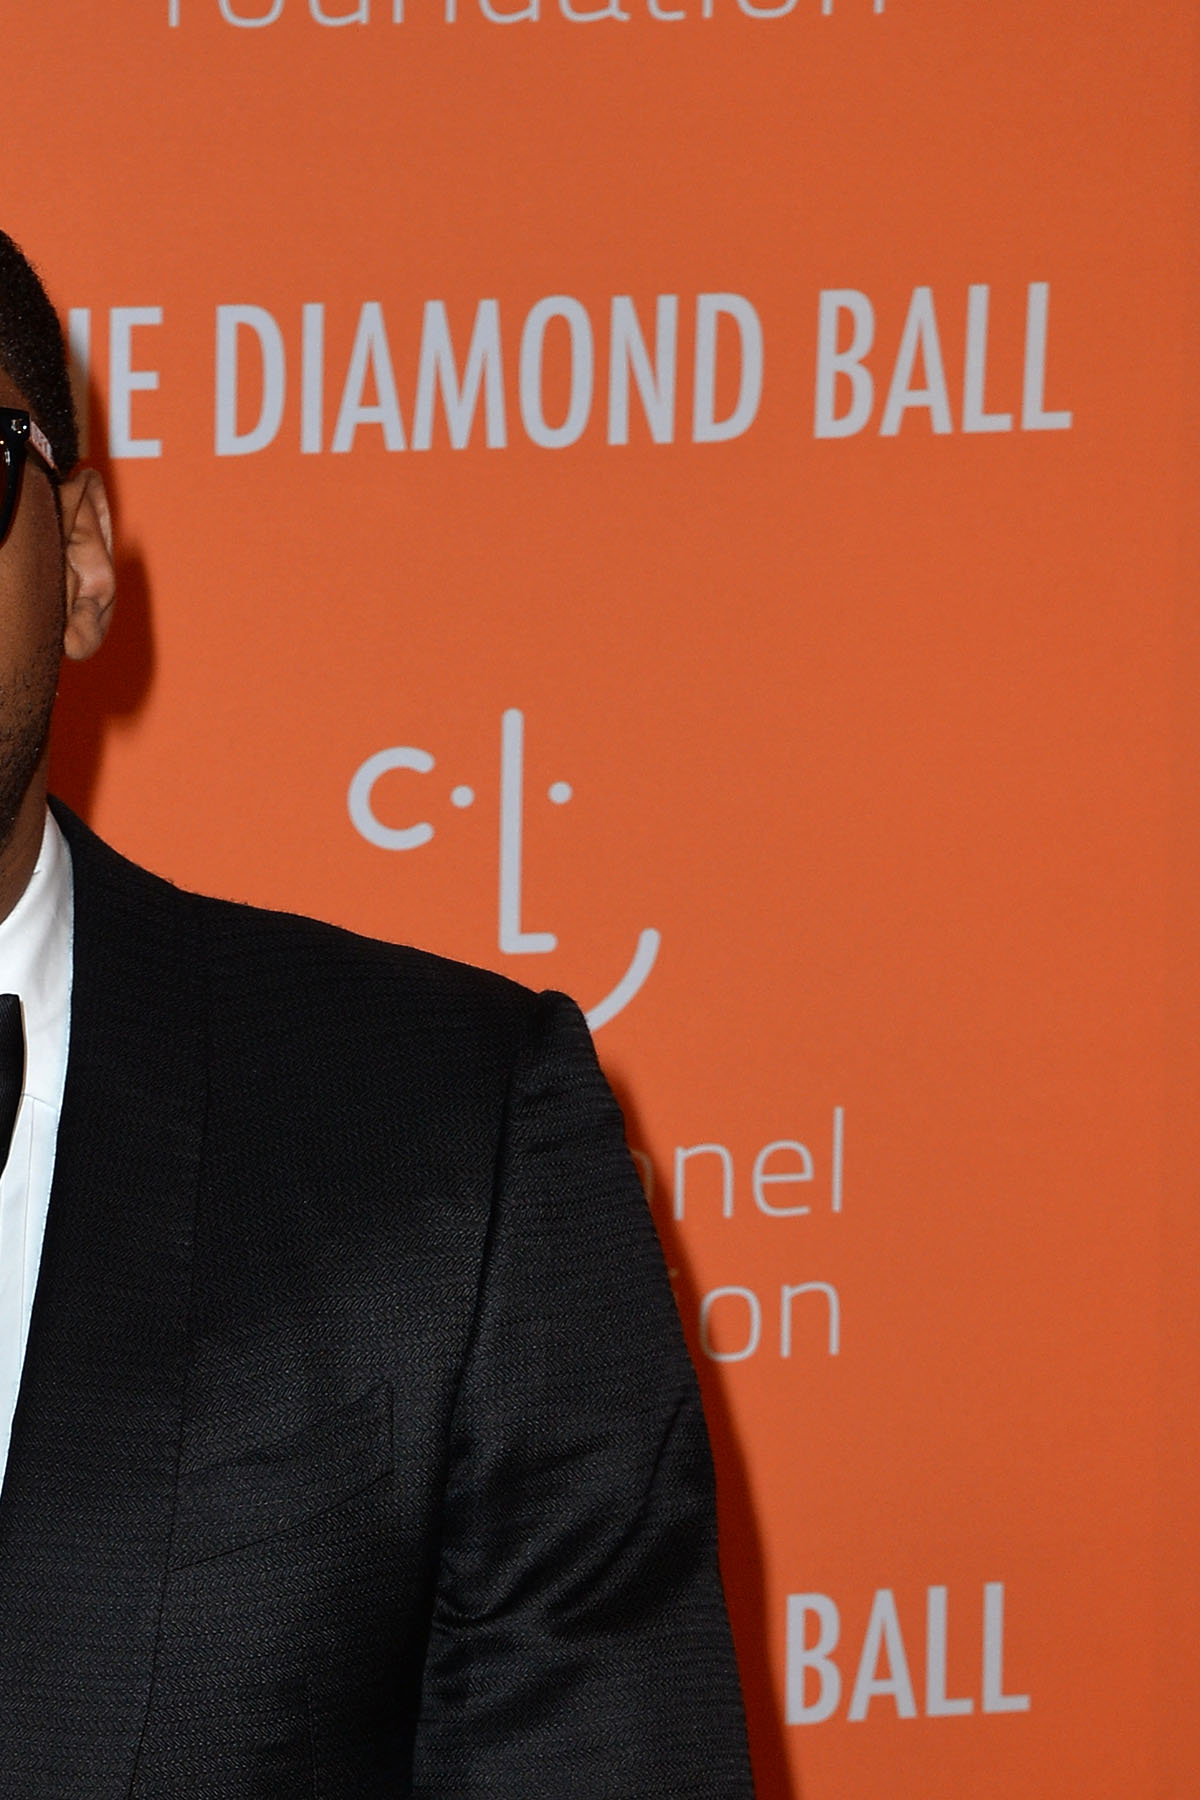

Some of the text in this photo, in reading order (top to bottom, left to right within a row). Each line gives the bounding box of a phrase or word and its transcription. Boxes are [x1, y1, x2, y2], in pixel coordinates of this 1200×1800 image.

[213, 291, 765, 458] DIAMOND
[812, 280, 1074, 440] BALL
[784, 1580, 1032, 1727] BALL
